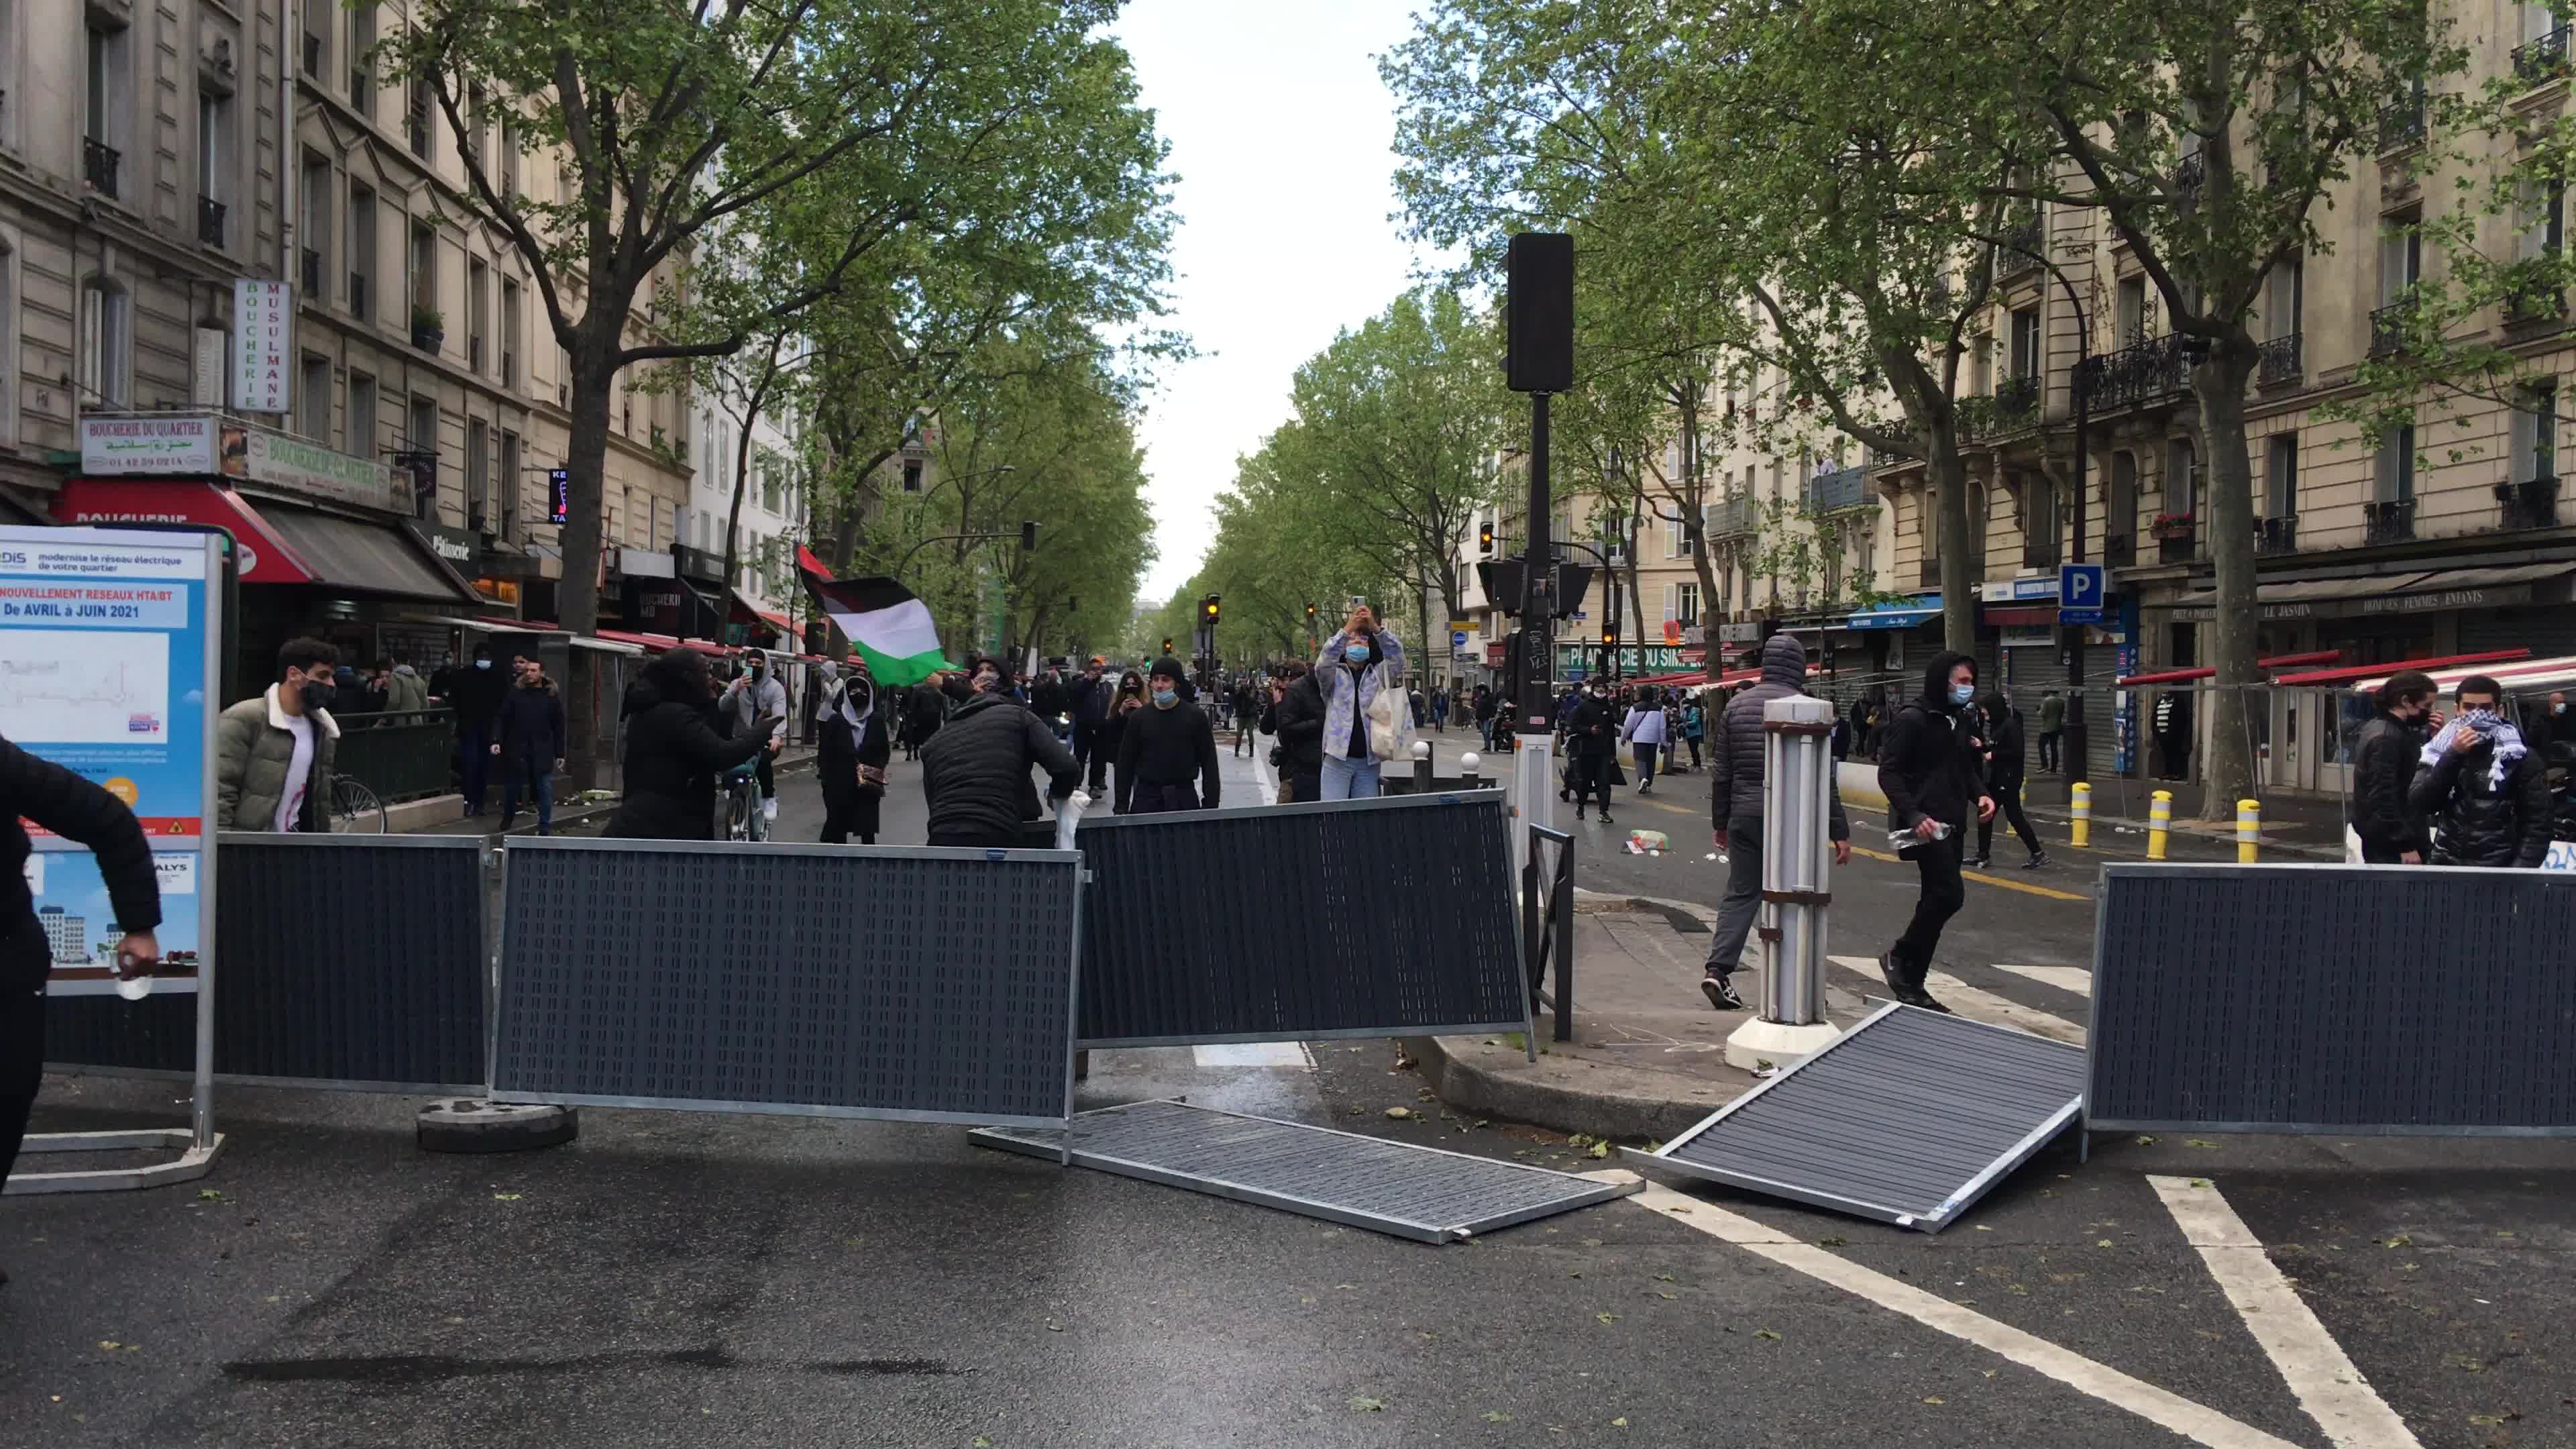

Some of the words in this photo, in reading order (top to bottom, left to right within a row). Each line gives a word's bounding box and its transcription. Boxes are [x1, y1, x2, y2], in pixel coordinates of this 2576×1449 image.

[246, 283, 258, 408] BOUCHERIE
[266, 283, 279, 408] MUSULMANE
[89, 423, 141, 436] BOUCHERIE
[144, 423, 155, 435] DU
[156, 423, 203, 436] QUARTIER
[38, 553, 88, 562] modernise
[90, 554, 99, 562] le
[101, 555, 132, 564] réseau
[134, 555, 182, 566] électrique
[2072, 573, 2090, 599] P
[2445, 590, 2483, 605] ENFANTS
[4, 603, 19, 616] De
[24, 604, 61, 616] AVRIL
[65, 606, 72, 616] à
[76, 605, 106, 617] JUIN
[111, 605, 139, 618] 2021
[2264, 606, 2275, 618] LE
[2278, 604, 2312, 617] JASMIN
